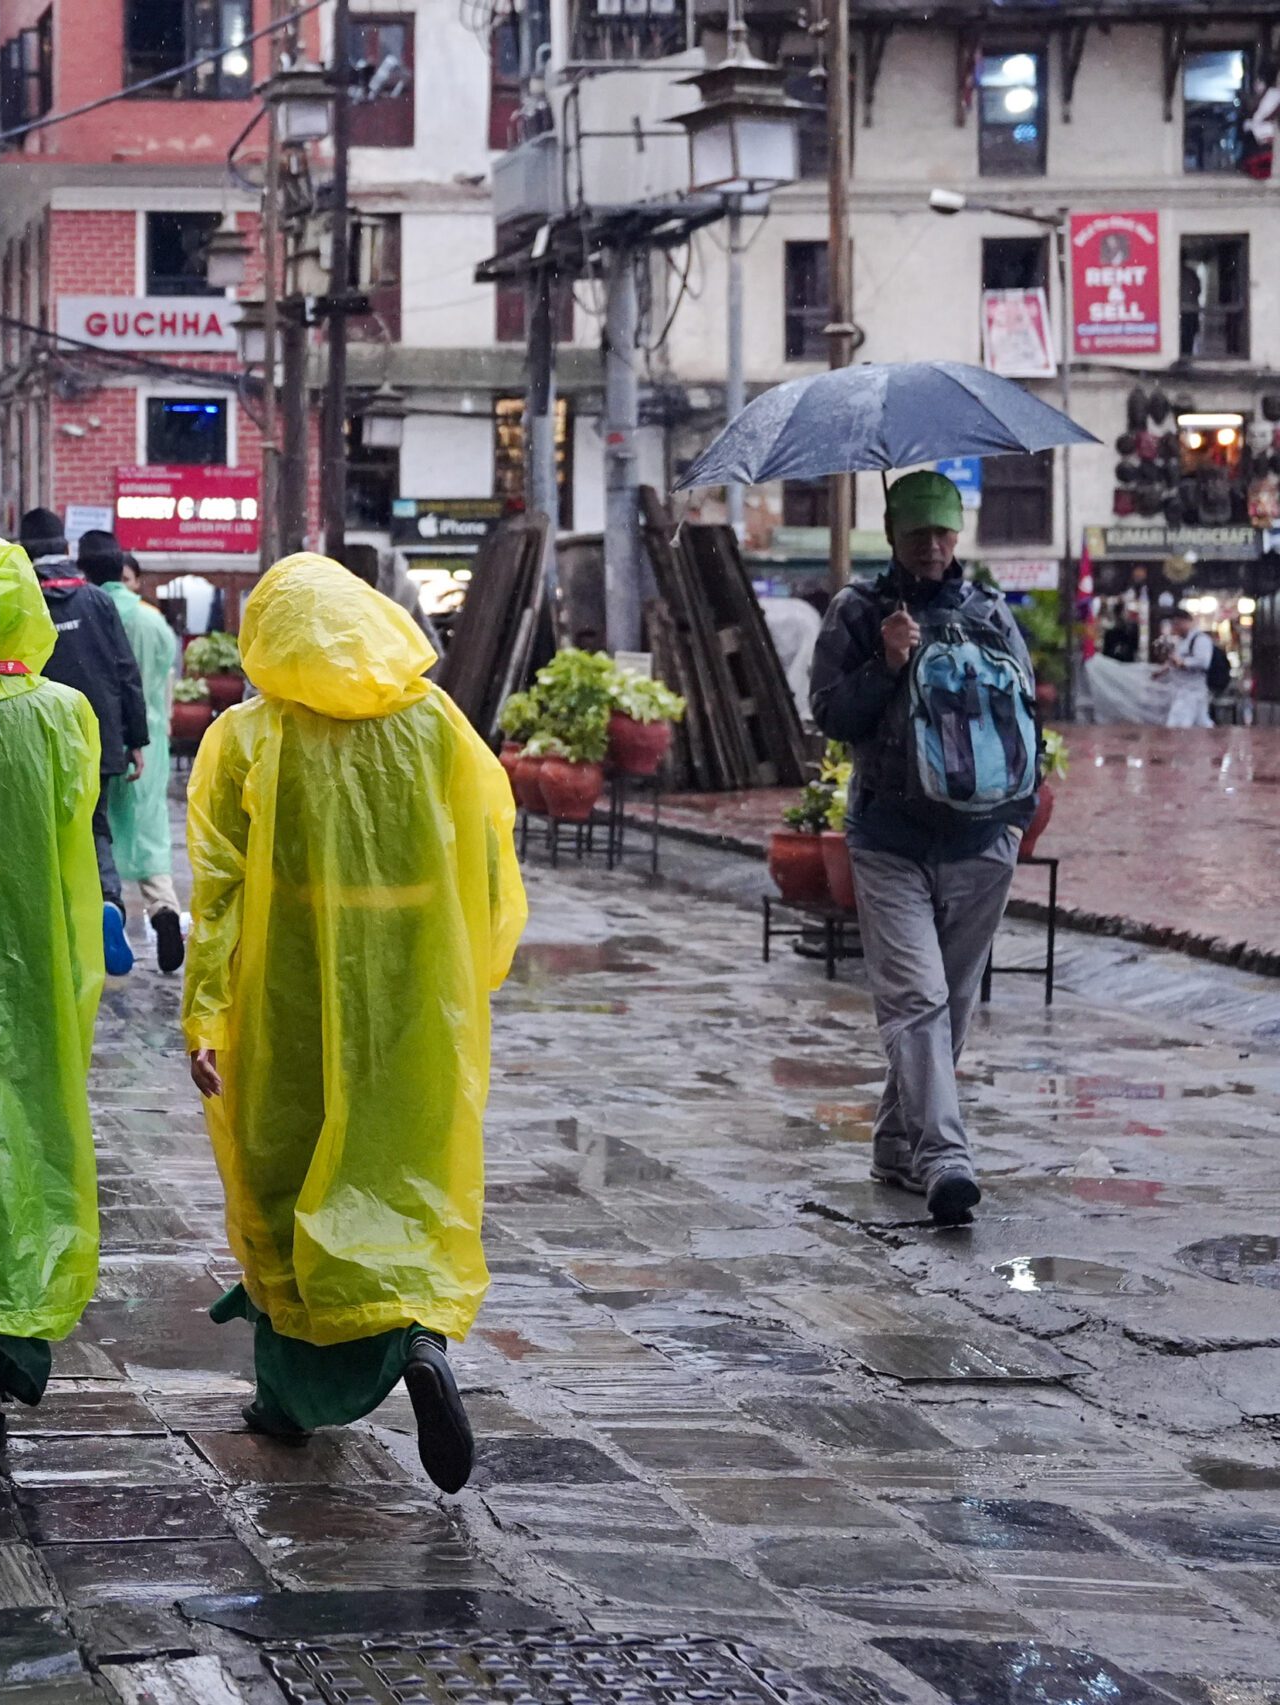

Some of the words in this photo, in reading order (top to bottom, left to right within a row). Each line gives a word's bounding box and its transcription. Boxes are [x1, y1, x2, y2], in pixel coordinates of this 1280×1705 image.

[1085, 265, 1147, 287] RENT
[1088, 302, 1145, 321] SELL
[84, 311, 224, 338] GUCHHA
[439, 518, 487, 535] iPhone
[1106, 527, 1165, 546] KUMARI
[1166, 526, 1255, 545] HANDICRAFT
